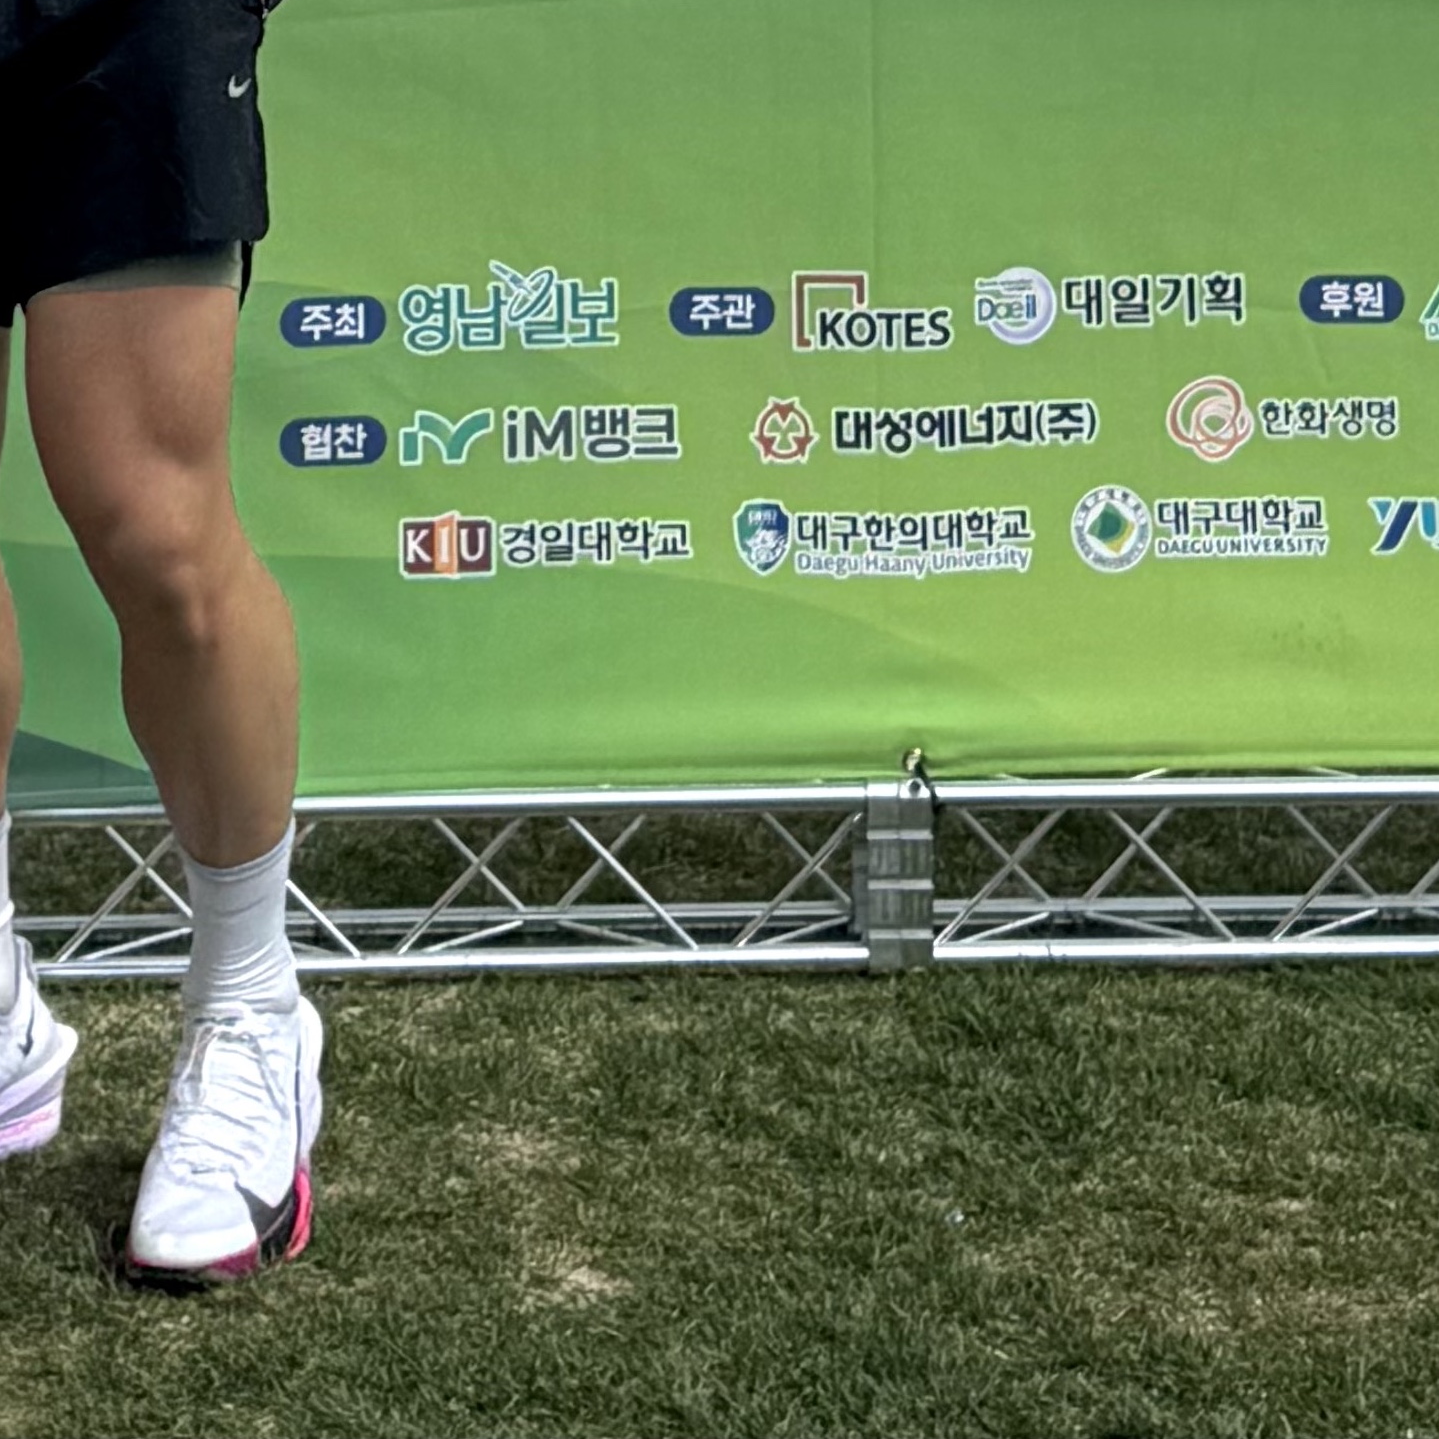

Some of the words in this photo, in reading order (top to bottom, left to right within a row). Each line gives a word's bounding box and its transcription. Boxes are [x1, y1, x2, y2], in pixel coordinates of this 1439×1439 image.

[689, 293, 756, 331] 주관
[1064, 274, 1244, 325] 대일기획
[1320, 281, 1385, 318] 후원
[300, 303, 365, 342] 주최
[819, 310, 951, 348] KOTES
[507, 407, 680, 459] iM뱅크
[835, 401, 1098, 454] 대성에너지(주)
[1261, 398, 1397, 438] 한화생명
[300, 422, 366, 462] 협찬
[797, 509, 1031, 552] 대구한의대학교
[1158, 498, 1324, 535] 대구대학교
[406, 524, 486, 563] KIU
[503, 520, 689, 564] 경일대학교
[797, 552, 859, 575] Daegu
[865, 552, 926, 577] Haany
[932, 547, 1029, 570] University
